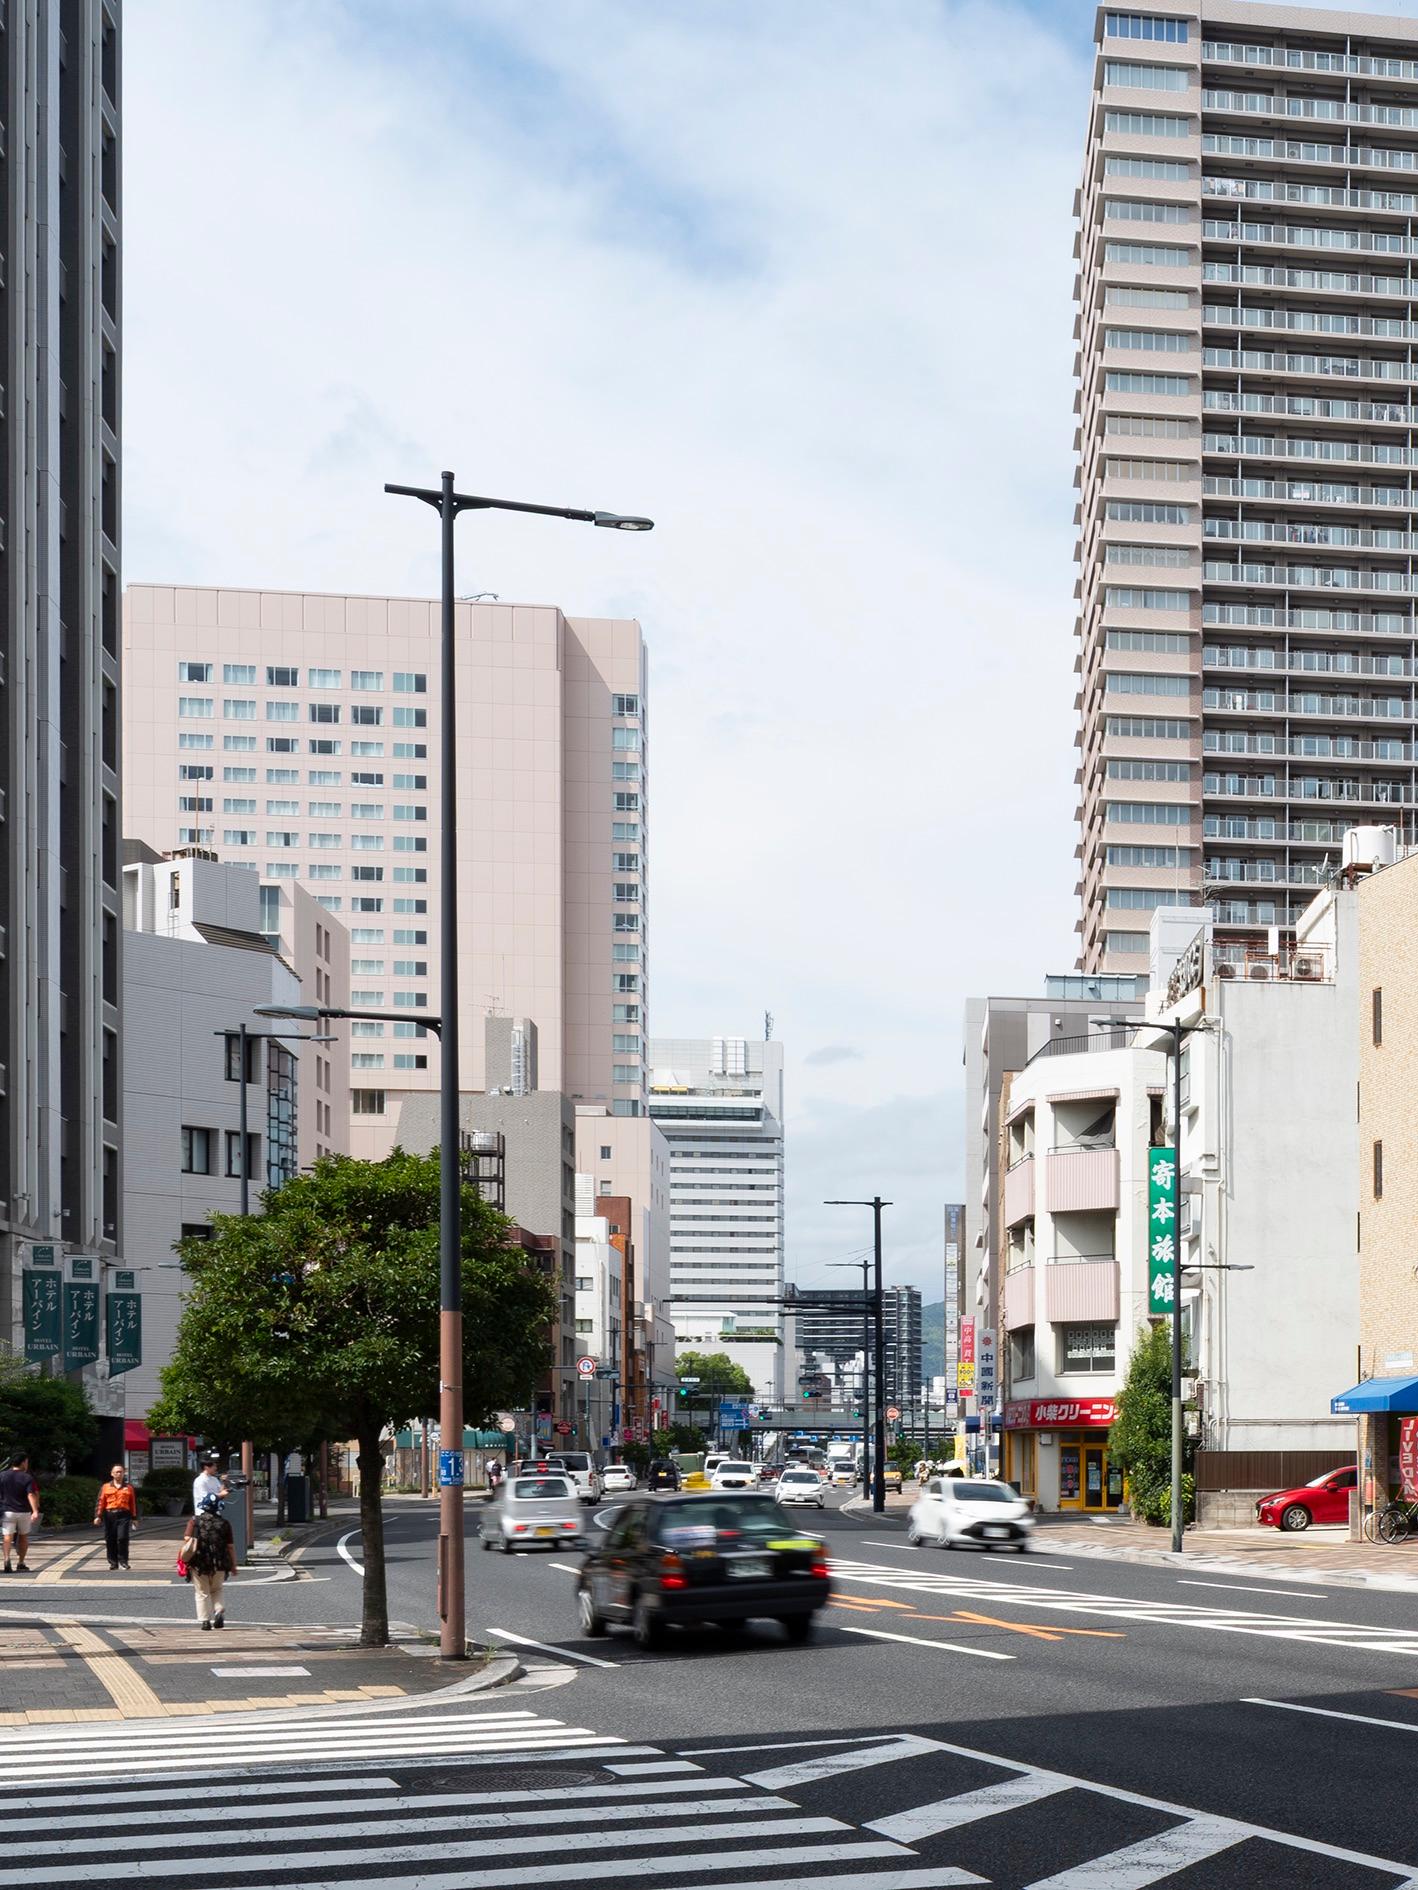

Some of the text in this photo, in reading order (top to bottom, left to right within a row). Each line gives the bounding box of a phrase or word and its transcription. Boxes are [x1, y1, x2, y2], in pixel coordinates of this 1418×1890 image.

[1151, 1159, 1176, 1304] 寄本旅館
[31, 1279, 43, 1331] アーバイン
[45, 1278, 57, 1312] ホテル
[70, 1290, 82, 1339] アーバイン
[83, 1290, 94, 1321] ホテル
[126, 1299, 137, 1329] ホテル
[113, 1300, 125, 1346] アーバイン
